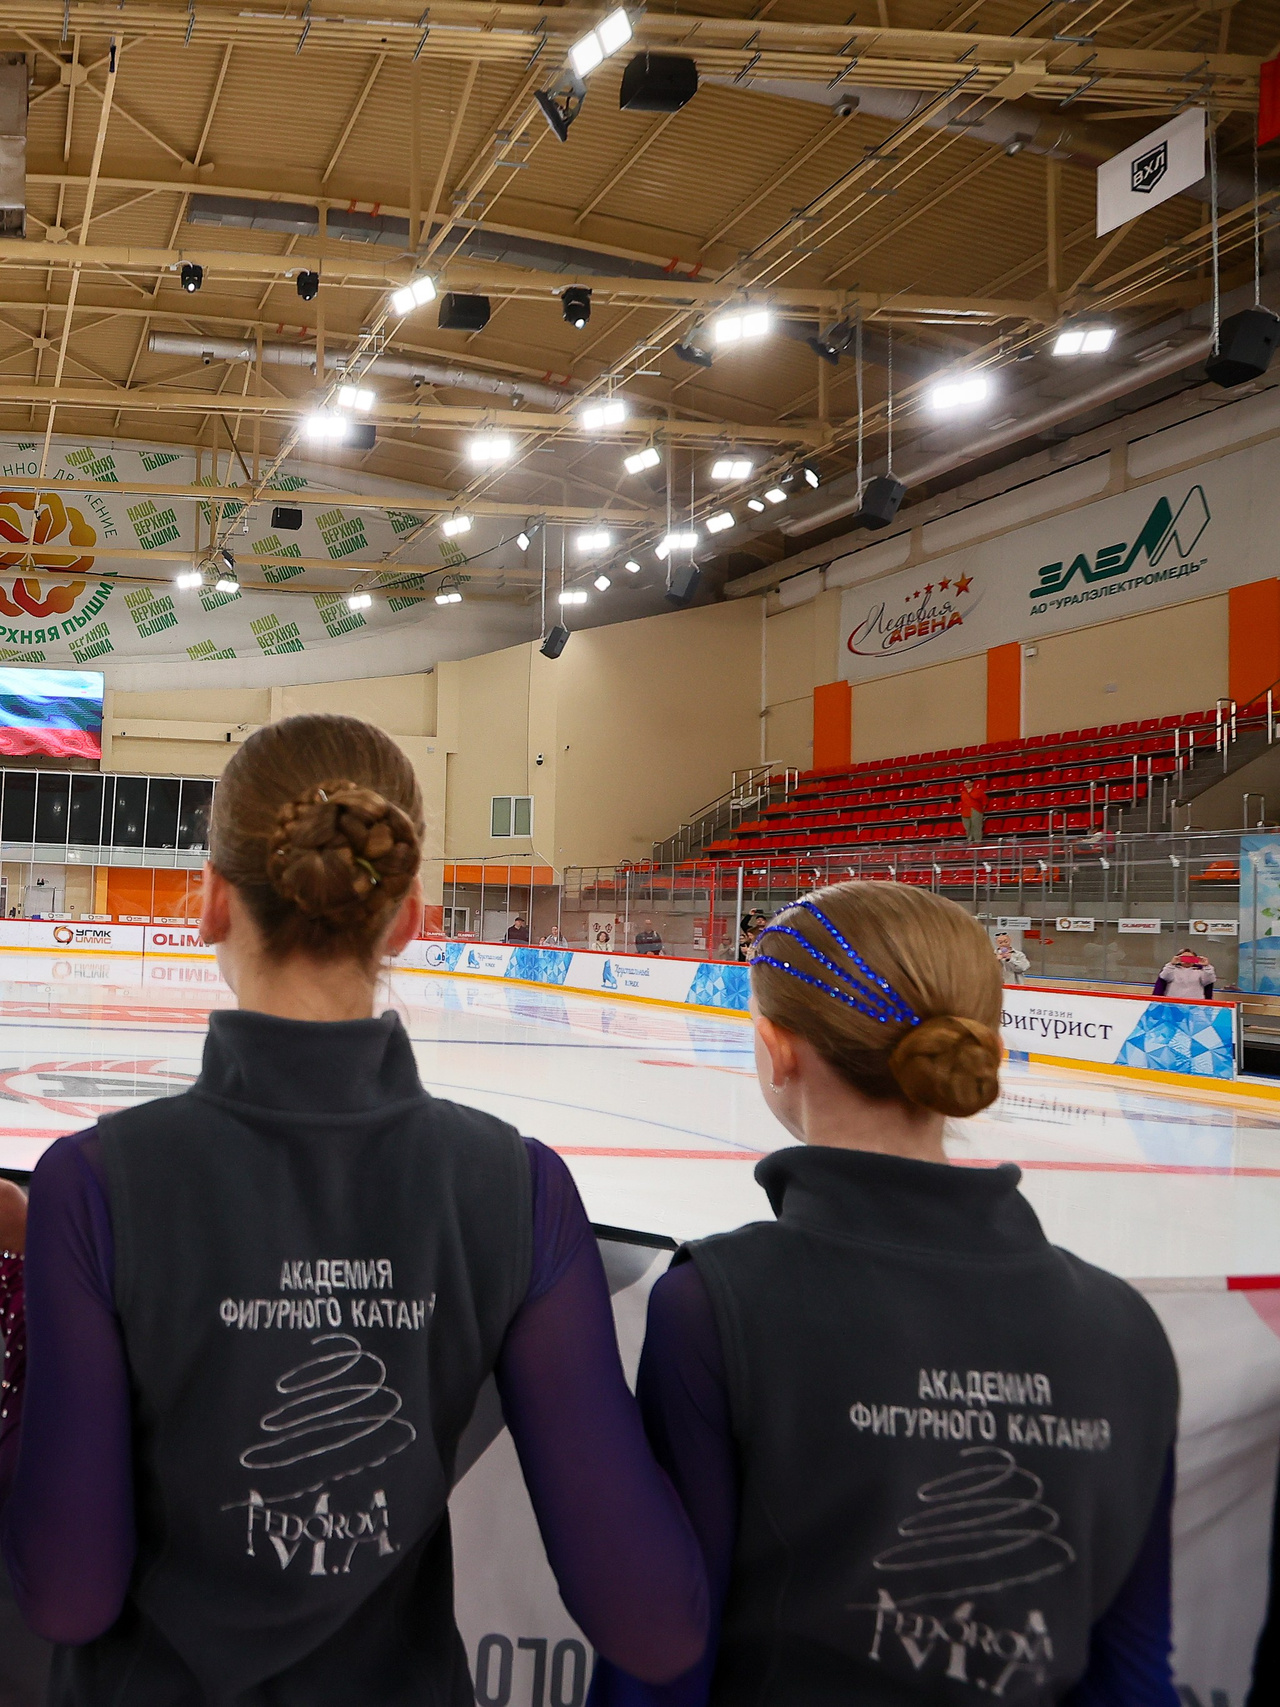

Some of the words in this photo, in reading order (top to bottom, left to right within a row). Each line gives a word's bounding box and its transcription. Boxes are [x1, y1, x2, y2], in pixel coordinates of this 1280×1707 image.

[1133, 150, 1165, 187] ВХЛ
[65, 446, 95, 466] НАША
[126, 500, 157, 522] НАША
[132, 508, 178, 537] ВЕРХНЯЯ
[315, 508, 345, 530] НАША
[138, 524, 181, 550] ПЫШМА
[321, 517, 365, 545] ВЕРХНЯЯ
[252, 534, 282, 555] НАША
[327, 533, 369, 559] ПЫШМА
[123, 586, 155, 609] НАША
[130, 595, 175, 624] ВЕРХНЯЯ
[1029, 605, 1048, 616] АО
[136, 611, 178, 639] ПЫШМА
[250, 613, 280, 635] НАША
[256, 621, 300, 650] ВЕРХНЯЯ
[326, 612, 367, 638] ПЫШМА
[888, 611, 964, 645] АРЕНА
[72, 638, 115, 664] ПЫШМА
[186, 639, 217, 660] НАША
[75, 928, 111, 938] УГМК
[1122, 922, 1156, 930] OLIMPBET
[75, 936, 112, 944] UMMC
[1000, 1009, 1113, 1040] Фигурист
[1029, 1007, 1073, 1018] магазин
[280, 1258, 393, 1295] АКАДЕМИЯ
[219, 1296, 342, 1331] ФИГУРНОГО
[918, 1368, 1053, 1408] АКАДЕМИЯ
[849, 1402, 997, 1441] ФИГУРНОГО
